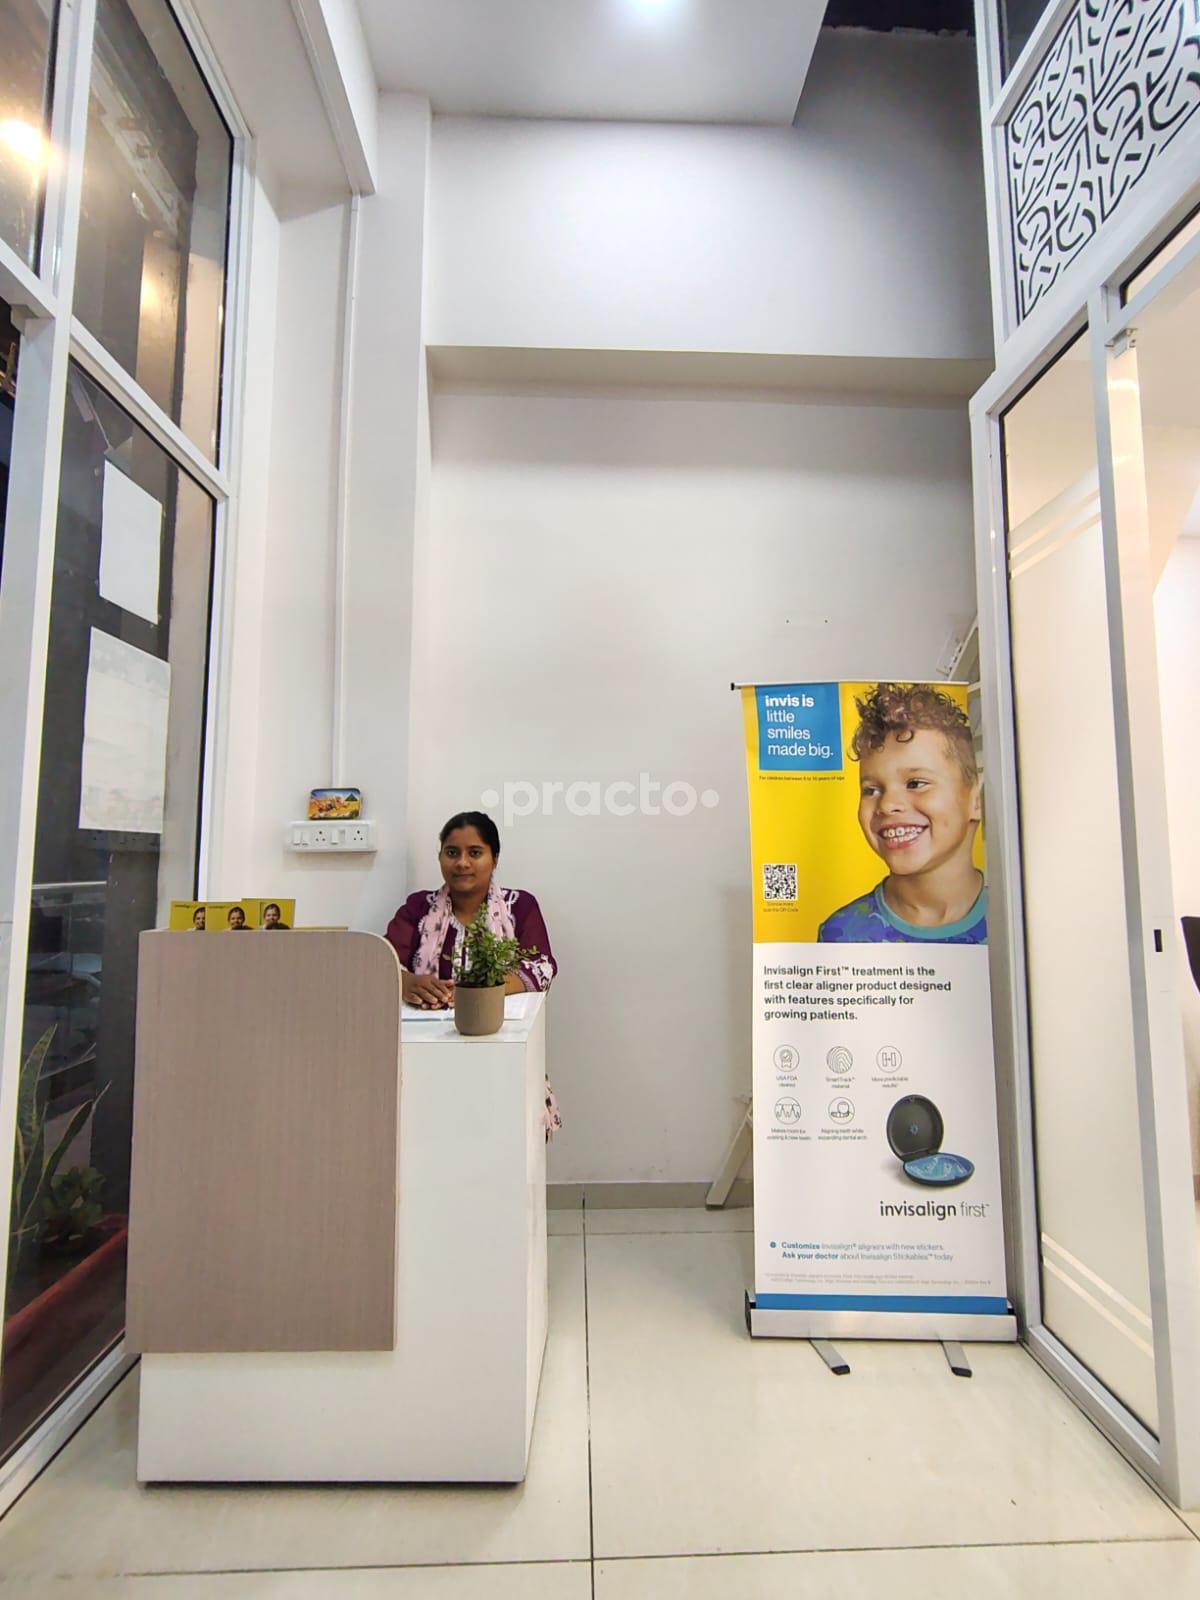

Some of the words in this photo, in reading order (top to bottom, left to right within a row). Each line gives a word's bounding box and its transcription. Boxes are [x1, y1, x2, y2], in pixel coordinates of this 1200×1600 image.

[765, 694, 800, 707] invis
[801, 694, 815, 707] is
[766, 709, 795, 723] little
[767, 726, 811, 740] smiles
[767, 742, 807, 756] made
[808, 742, 834, 759] big.
[763, 966, 814, 977] Invisalign
[852, 967, 903, 977] treatment
[905, 966, 915, 977] is
[917, 966, 935, 977] the
[763, 980, 784, 991] first
[785, 980, 813, 991] clear
[815, 981, 853, 993] aligner
[855, 981, 898, 993] product
[899, 981, 952, 993] designed
[764, 995, 786, 1005] with
[788, 995, 835, 1006] features
[836, 995, 896, 1008] specifically
[898, 996, 914, 1005] for
[764, 1009, 808, 1021] growing
[809, 1010, 858, 1021] patients.
[880, 1200, 957, 1221] invisalign
[781, 1241, 820, 1250] Customize
[885, 1243, 900, 1251] with
[782, 1251, 797, 1259] Ask
[797, 1252, 814, 1260] your
[815, 1252, 839, 1260] doctor
